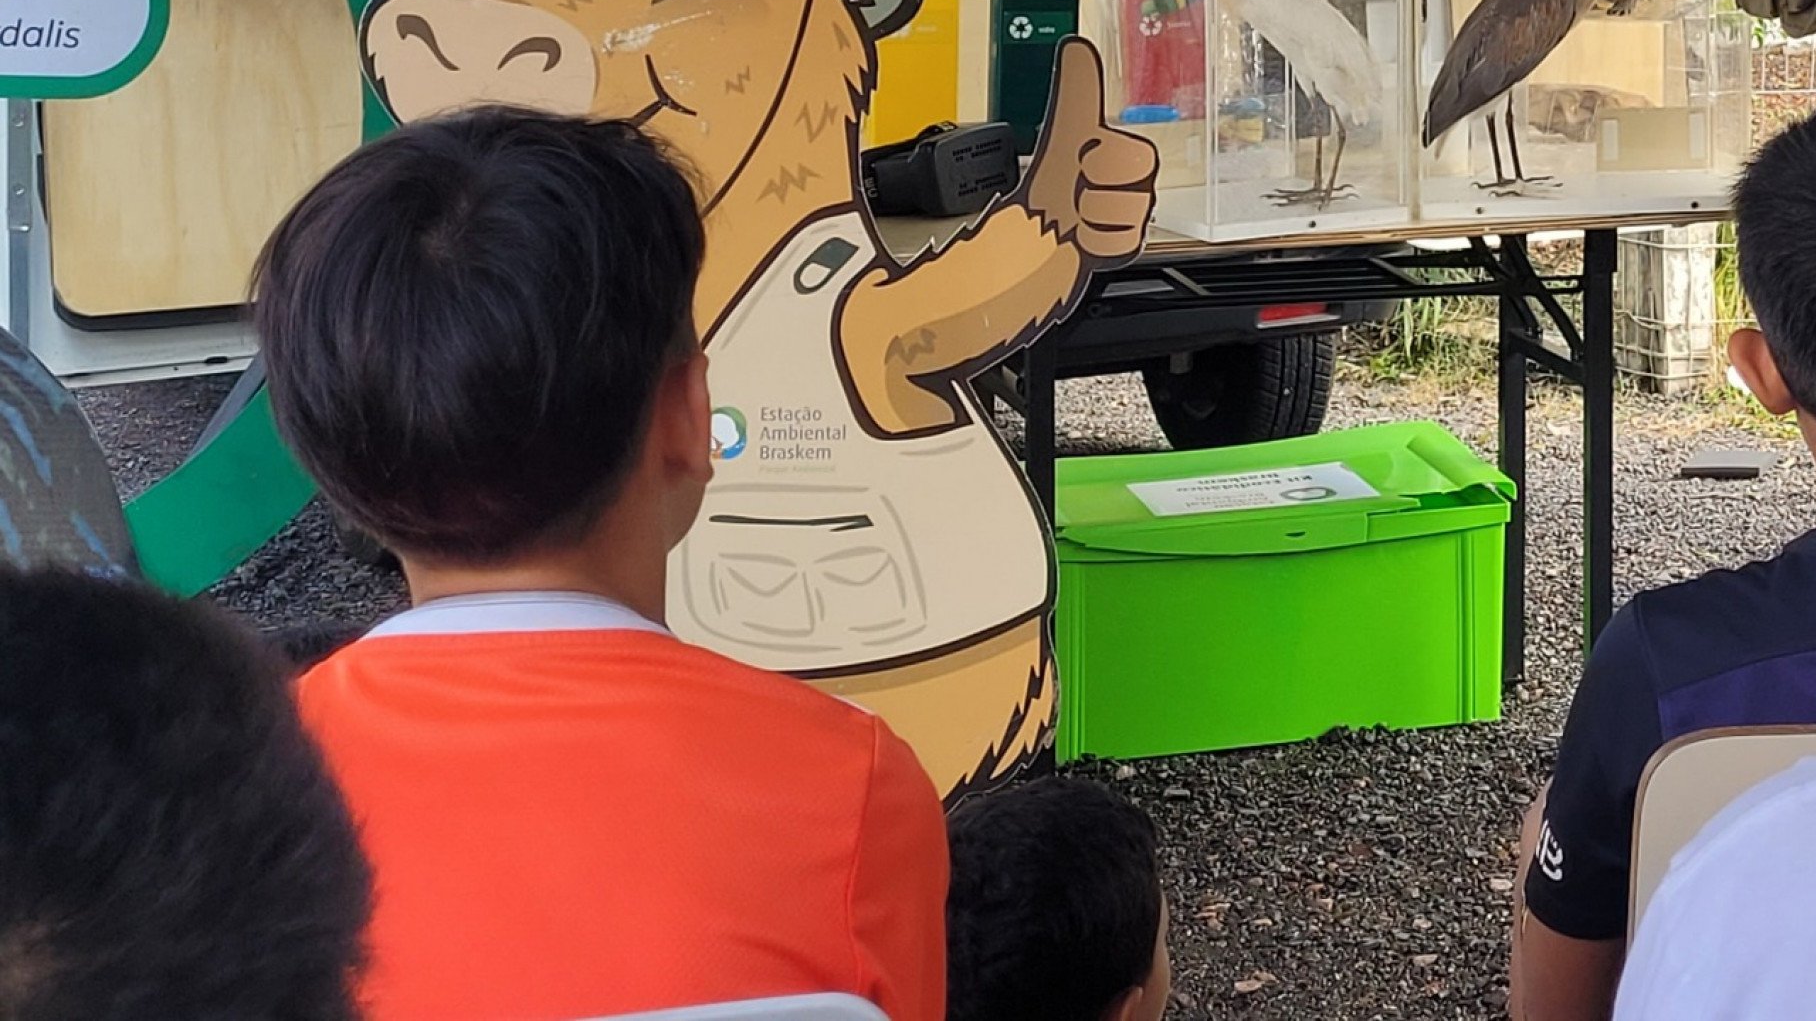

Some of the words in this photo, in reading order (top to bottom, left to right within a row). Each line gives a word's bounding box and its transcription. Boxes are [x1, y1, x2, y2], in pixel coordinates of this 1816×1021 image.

[0, 18, 81, 49] dalis
[760, 406, 822, 425] Estação
[759, 424, 847, 441] Ambiental
[759, 444, 832, 460] Braskem
